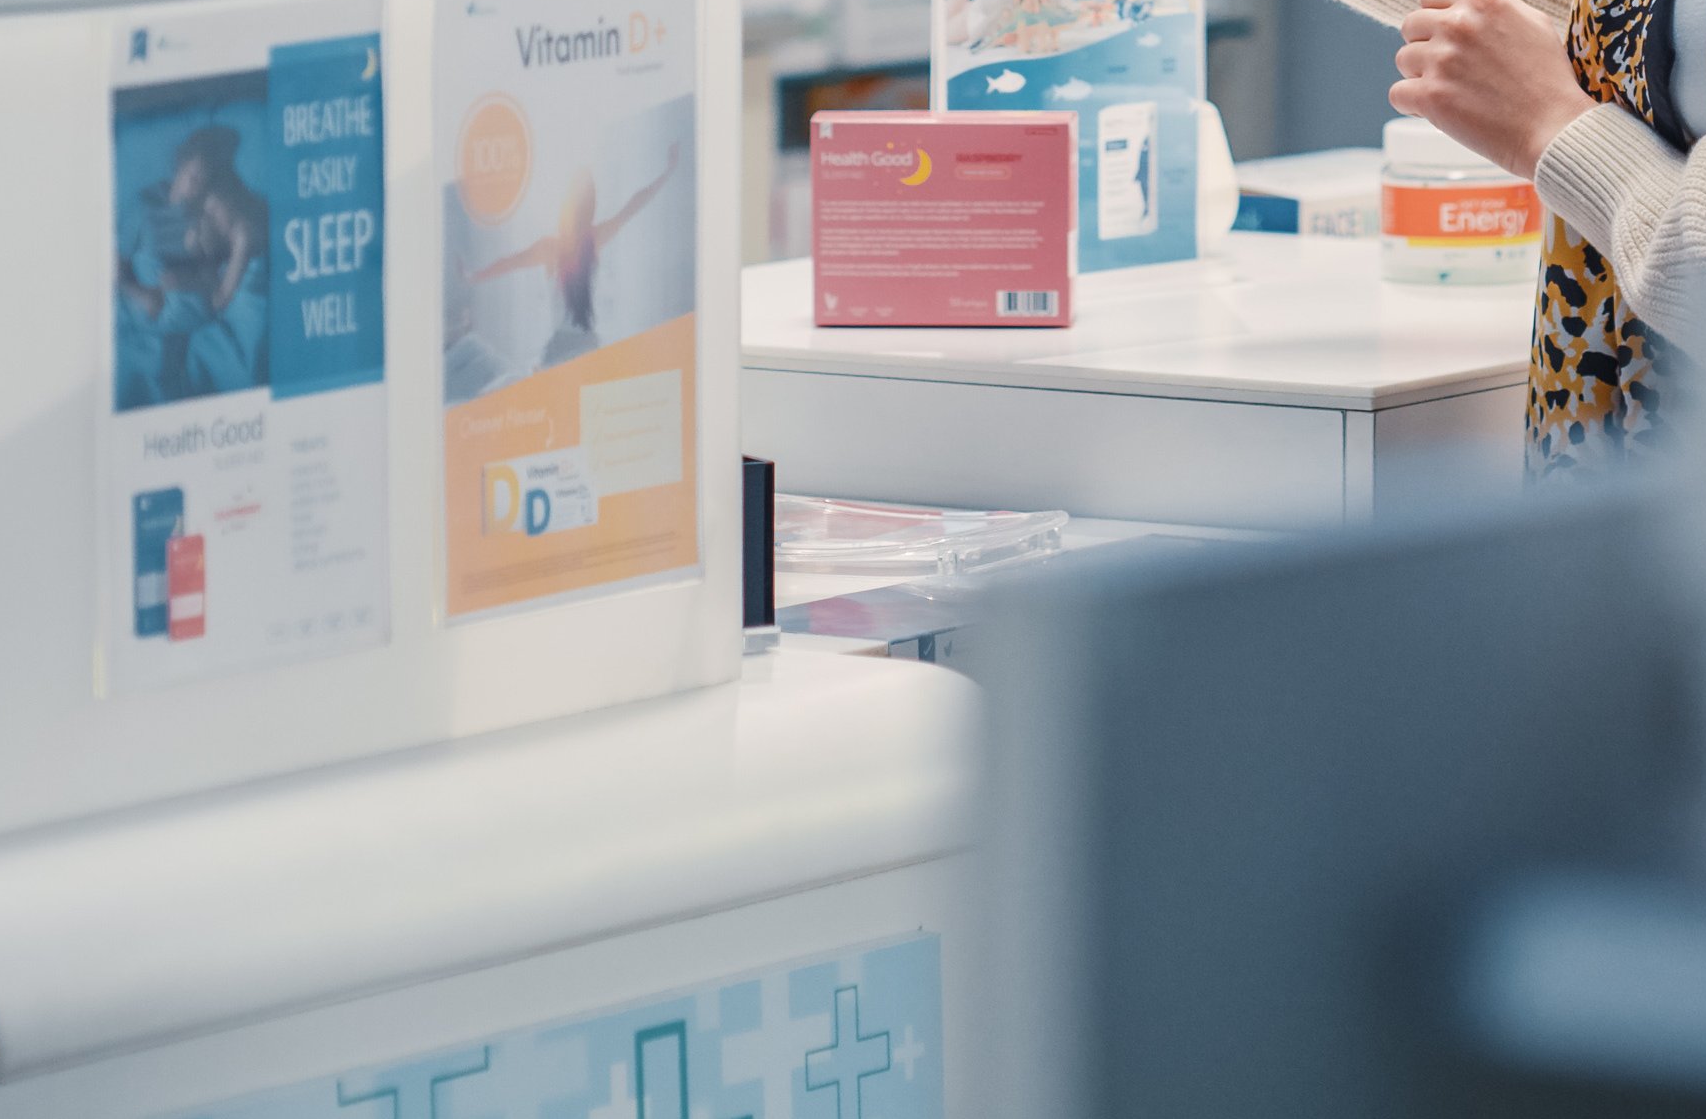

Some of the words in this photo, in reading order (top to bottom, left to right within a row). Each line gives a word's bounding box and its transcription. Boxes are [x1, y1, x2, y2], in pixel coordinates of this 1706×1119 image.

[515, 15, 621, 68] Vitamin
[628, 11, 668, 54] D+
[283, 94, 375, 147] BREATHE
[297, 153, 357, 199] EASILY
[820, 150, 870, 167] Health
[871, 150, 913, 167] Good
[1310, 208, 1358, 237] FACE
[1439, 202, 1529, 238] Energy
[284, 209, 375, 283] SLEEP
[301, 292, 357, 340] WELL
[143, 424, 205, 459] Health
[210, 410, 264, 449] Good
[525, 488, 551, 537] D
